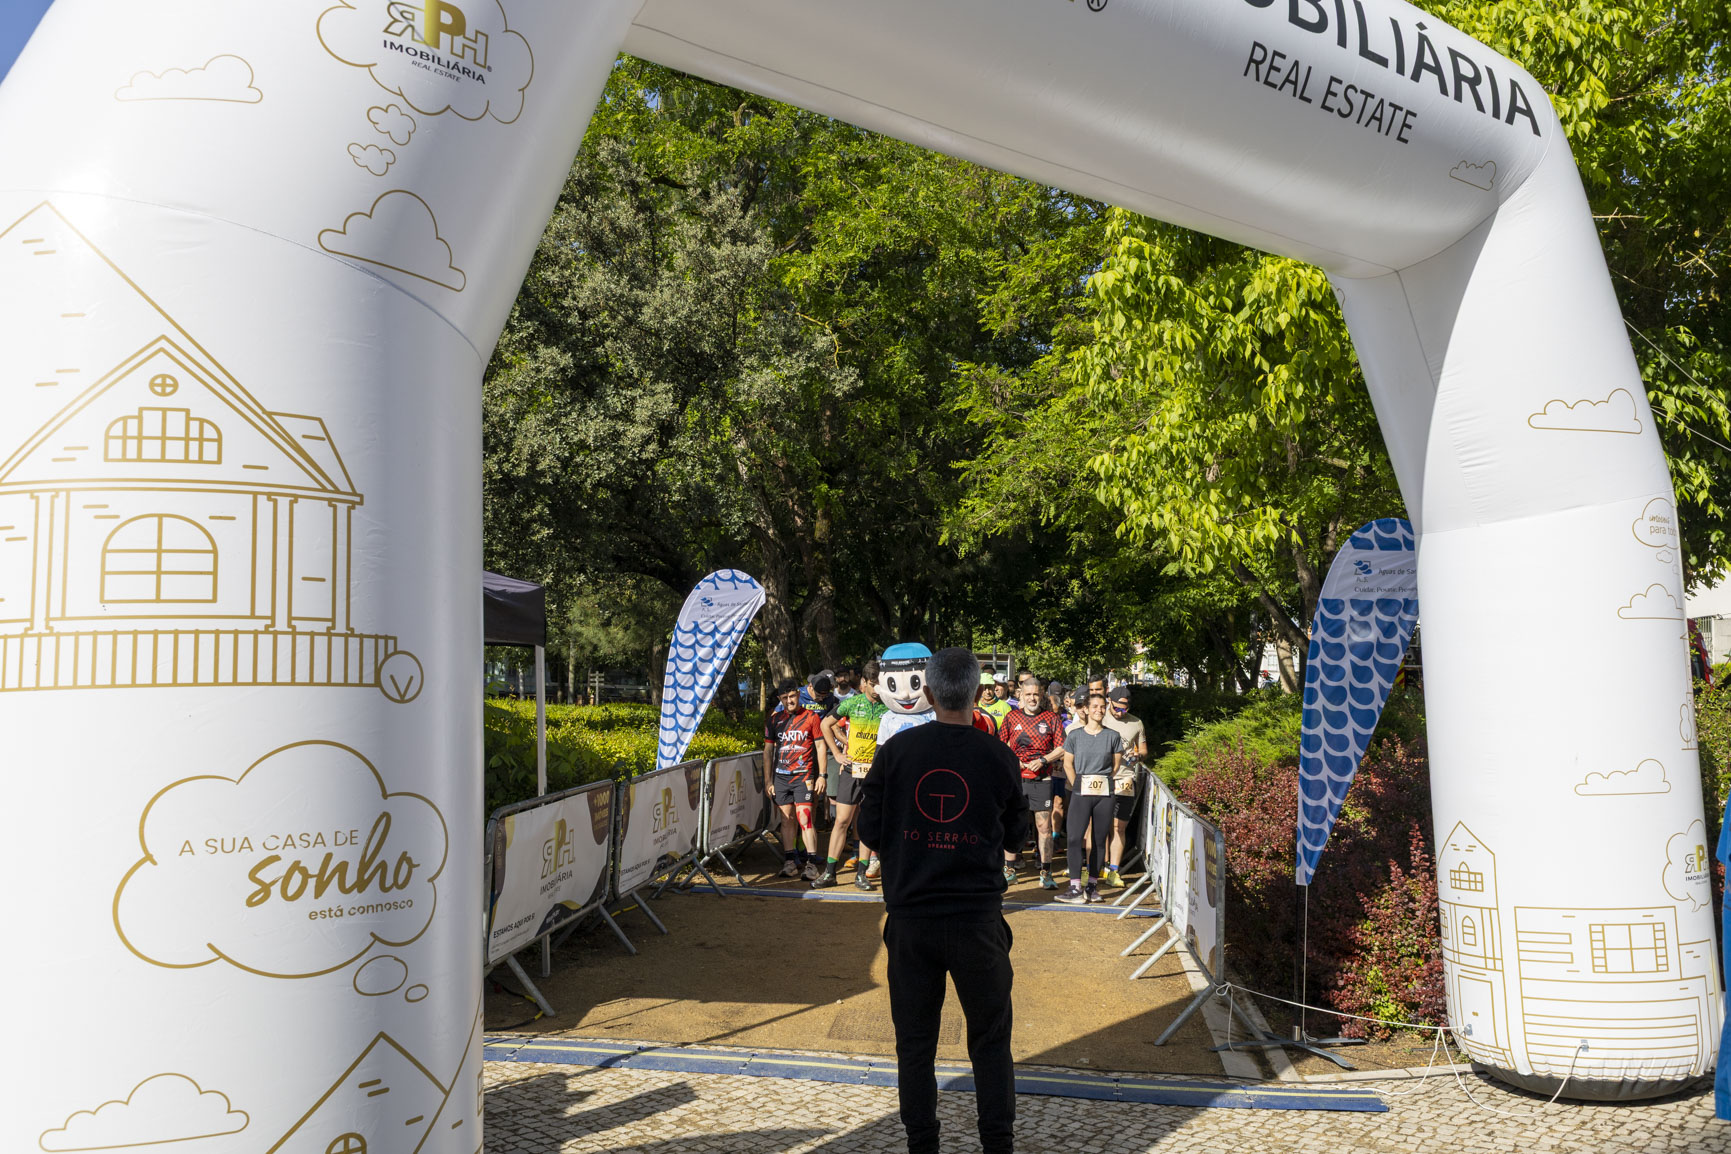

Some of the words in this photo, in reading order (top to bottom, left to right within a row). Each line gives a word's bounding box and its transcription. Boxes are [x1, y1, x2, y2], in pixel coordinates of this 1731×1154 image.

[383, 39, 486, 85] IMOBILIÁRIA
[411, 60, 432, 71] REAL
[434, 68, 462, 83] ESTATE
[1243, 0, 1541, 137] BILIÁRIA
[1243, 40, 1313, 103] REAL
[1320, 75, 1418, 144] ESTATE
[1088, 780, 1103, 789] 207
[178, 839, 195, 857] A
[204, 836, 254, 855] SUA
[262, 831, 327, 851] CASA
[334, 829, 360, 847] DE
[245, 811, 421, 908] sonho
[308, 905, 344, 921] está
[348, 899, 414, 917] connosco
